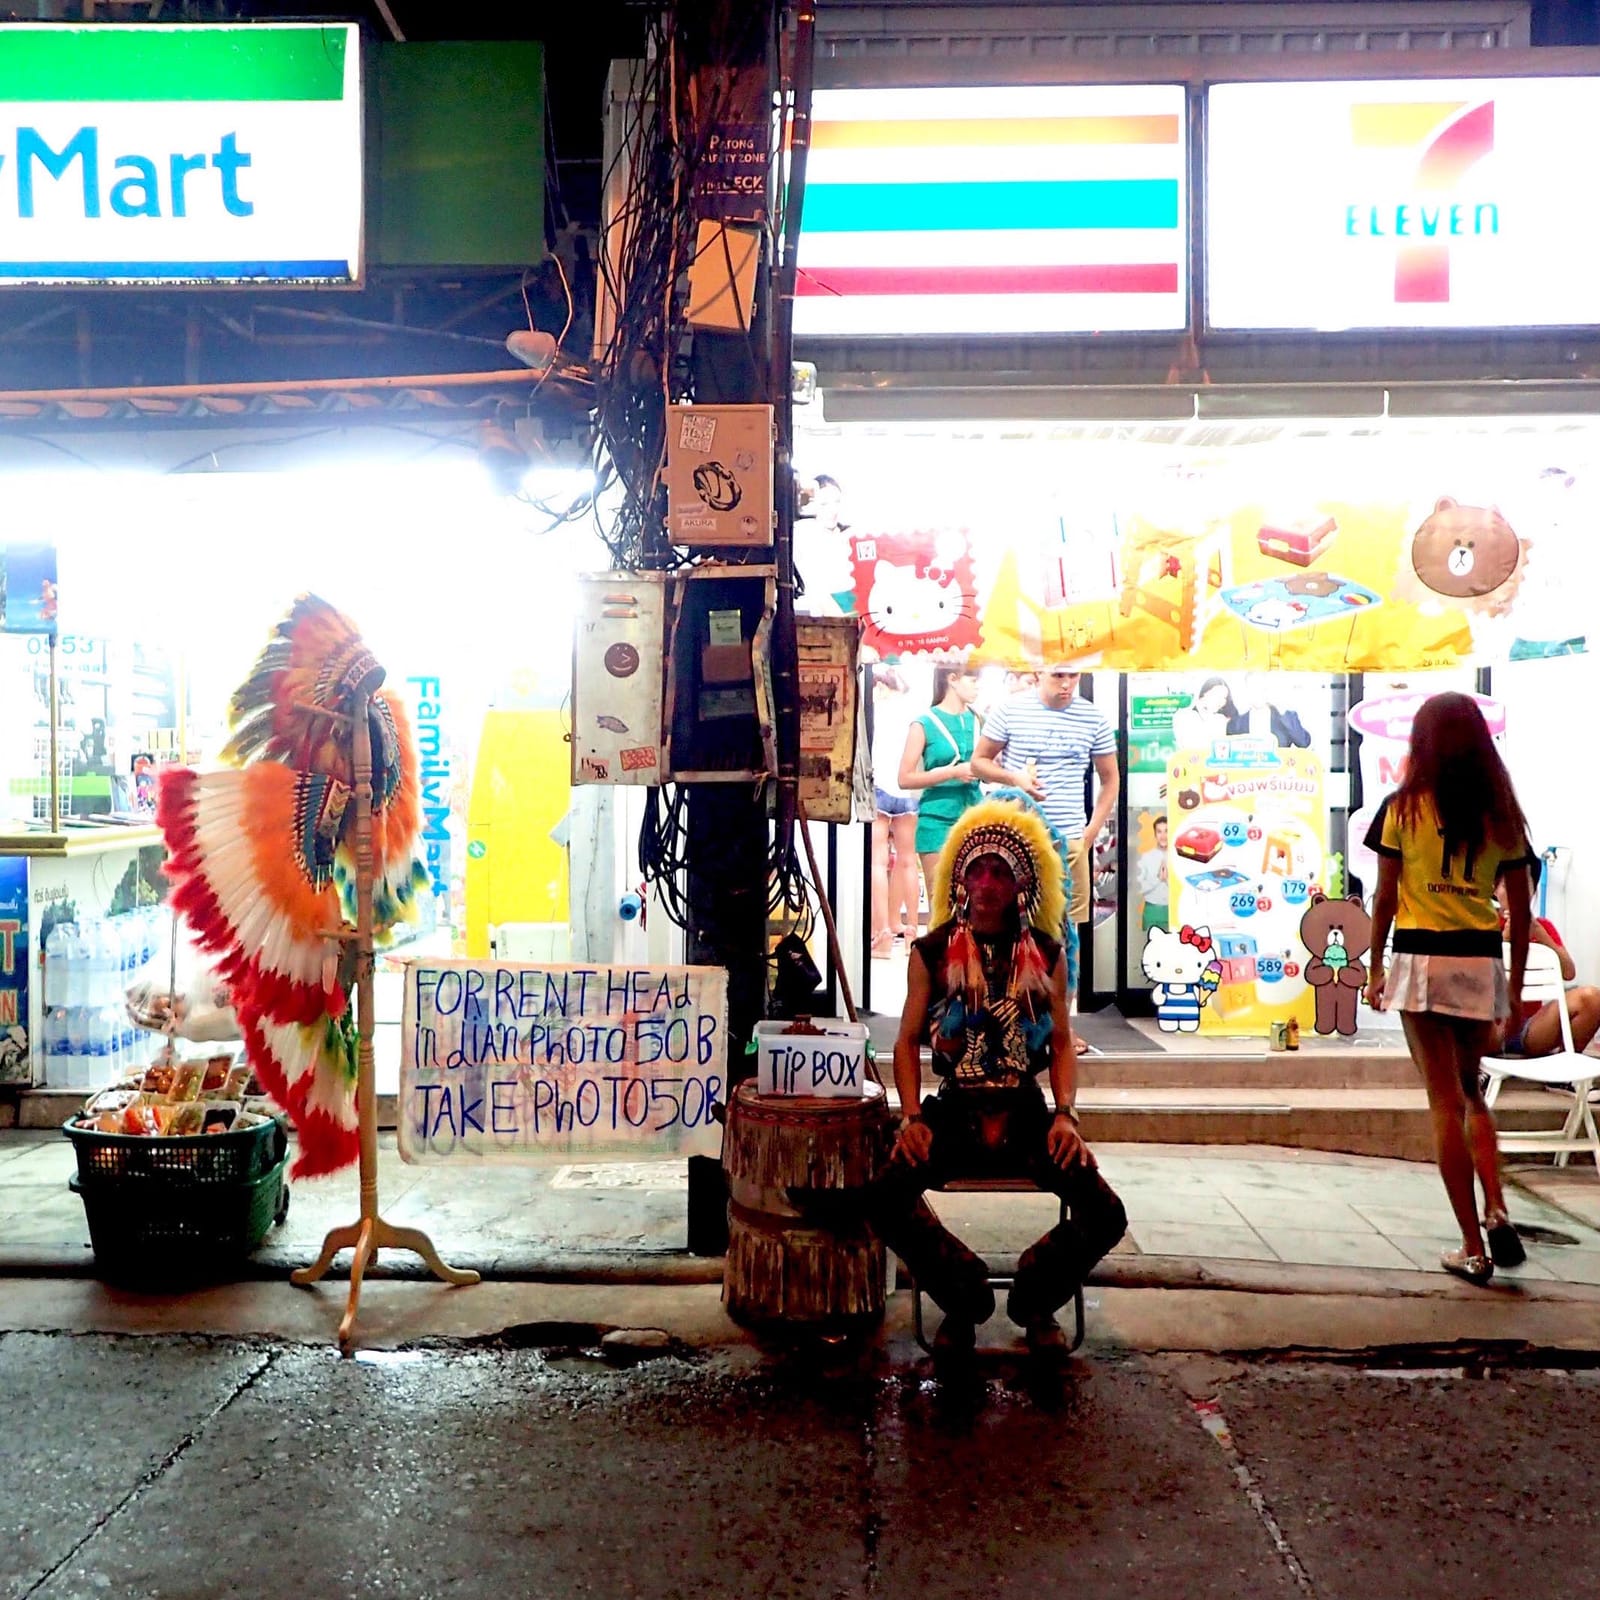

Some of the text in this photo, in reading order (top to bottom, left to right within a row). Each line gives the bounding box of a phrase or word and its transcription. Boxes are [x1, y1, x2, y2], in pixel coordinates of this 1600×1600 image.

[710, 135, 754, 149] PTONG
[739, 152, 765, 163] ZONE
[0, 126, 254, 218] Mart
[1223, 825, 1240, 837] 69
[1283, 882, 1306, 894] 179
[1231, 896, 1255, 908] 269
[1257, 961, 1282, 972] 589
[416, 969, 485, 1020] FOR
[496, 969, 596, 1019] RENT
[812, 1050, 860, 1087] BOX
